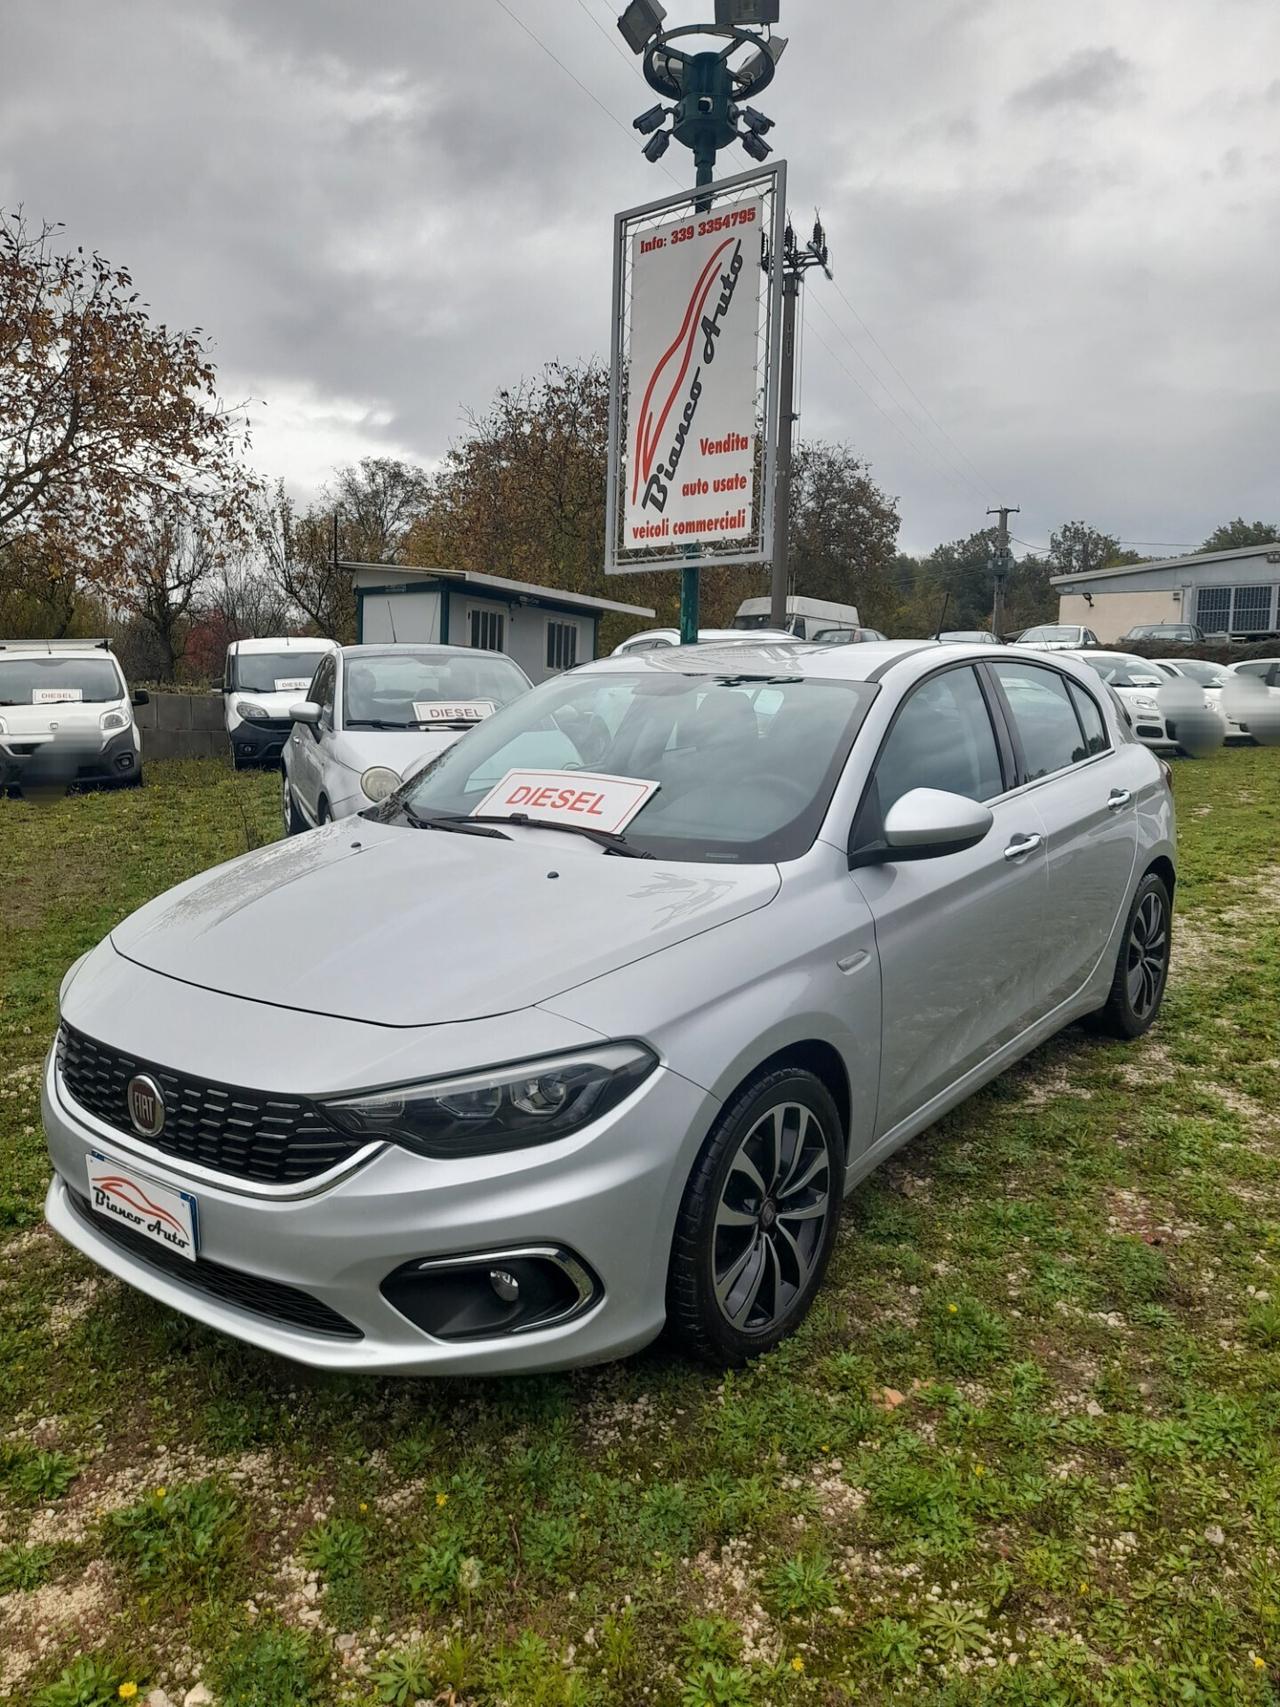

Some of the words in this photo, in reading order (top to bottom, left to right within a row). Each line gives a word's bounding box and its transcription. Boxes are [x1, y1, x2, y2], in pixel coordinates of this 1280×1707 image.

[640, 236, 667, 254] Info:
[671, 225, 694, 245] 339
[698, 207, 756, 236] 3354795
[642, 366, 702, 513] Bianco
[701, 239, 743, 365] Auto
[700, 432, 748, 456] Vendita
[682, 478, 709, 497] auto
[713, 473, 747, 493] usate
[633, 518, 669, 539] veicoli
[672, 508, 746, 535] commerciali
[281, 680, 308, 688] DIESEL
[429, 708, 483, 718] DIESEL
[505, 786, 606, 815] DIESEL
[133, 1091, 154, 1122] FIAT
[92, 1185, 145, 1226] Bianco
[147, 1219, 190, 1248] Auto
